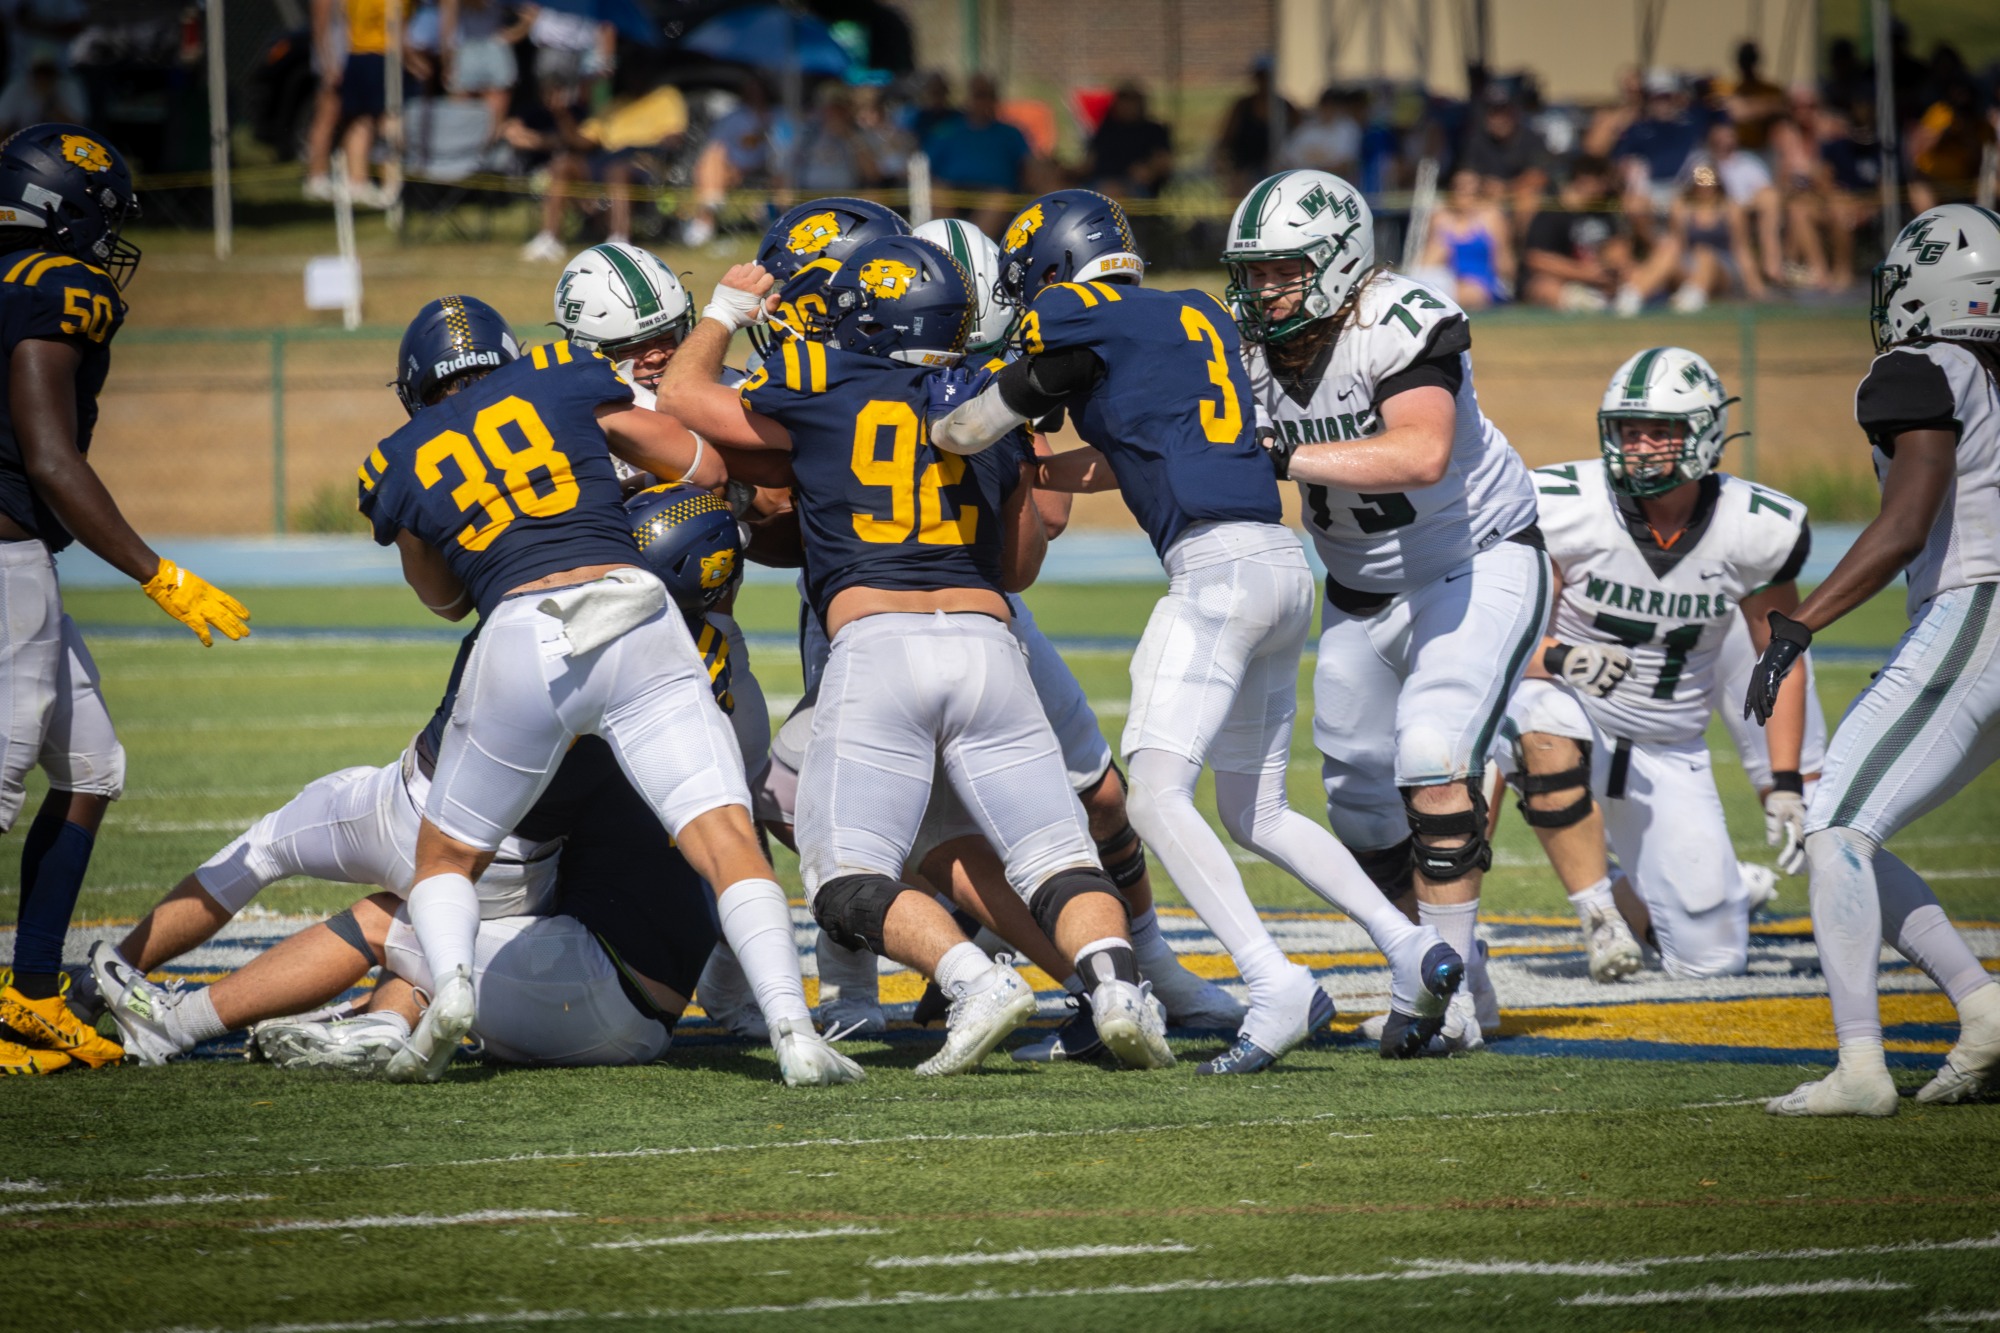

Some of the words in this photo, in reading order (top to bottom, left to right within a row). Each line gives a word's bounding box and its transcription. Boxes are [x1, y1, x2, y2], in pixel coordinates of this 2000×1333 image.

[1297, 184, 1361, 223] WLC
[1898, 218, 1950, 265] WLC
[60, 286, 113, 343] 50
[1020, 309, 1045, 355] 3
[434, 351, 501, 379] Riddell
[1180, 305, 1243, 444] 3
[414, 394, 581, 552] 38
[851, 399, 979, 545] 92
[1584, 571, 1728, 619] WARRIORS
[1593, 610, 1705, 701] 71
